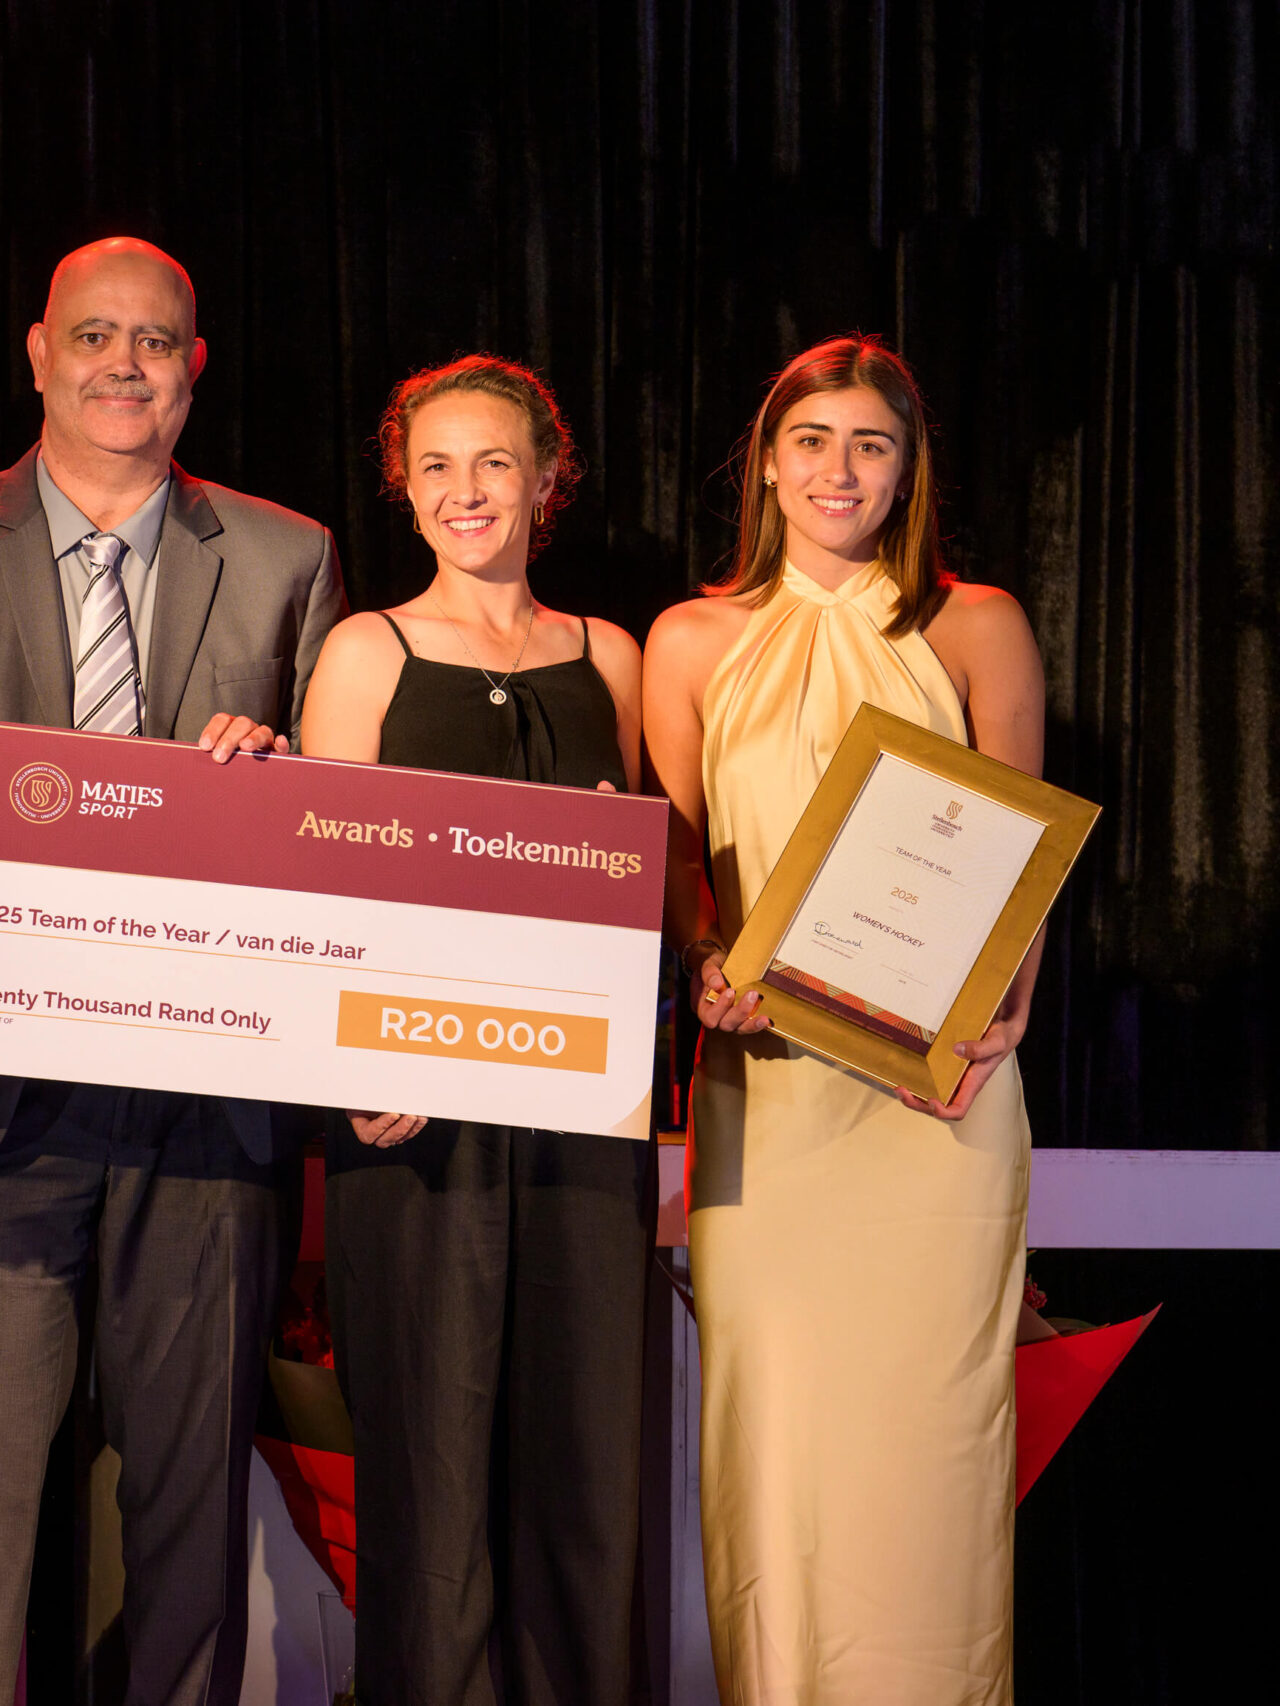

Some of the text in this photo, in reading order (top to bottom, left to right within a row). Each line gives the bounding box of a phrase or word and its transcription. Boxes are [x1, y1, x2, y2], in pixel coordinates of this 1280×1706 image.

[78, 802, 138, 820] SPORT
[81, 780, 163, 807] MATIES
[296, 811, 642, 879] Awards Toekennings
[895, 847, 952, 877] TEAM OF THE YEAR
[890, 886, 920, 906] 2025
[28, 908, 88, 931] Team
[93, 917, 117, 934] of
[120, 919, 157, 938] the
[162, 922, 210, 944] Year
[236, 934, 274, 951] van
[280, 935, 315, 955] die
[319, 940, 366, 960] Jaar
[852, 911, 926, 948] WOMEN'S HOCKEY
[43, 991, 153, 1018] Thousand
[158, 1002, 215, 1025] Rand
[220, 1008, 272, 1035] Only
[379, 1007, 566, 1057] R20 000
